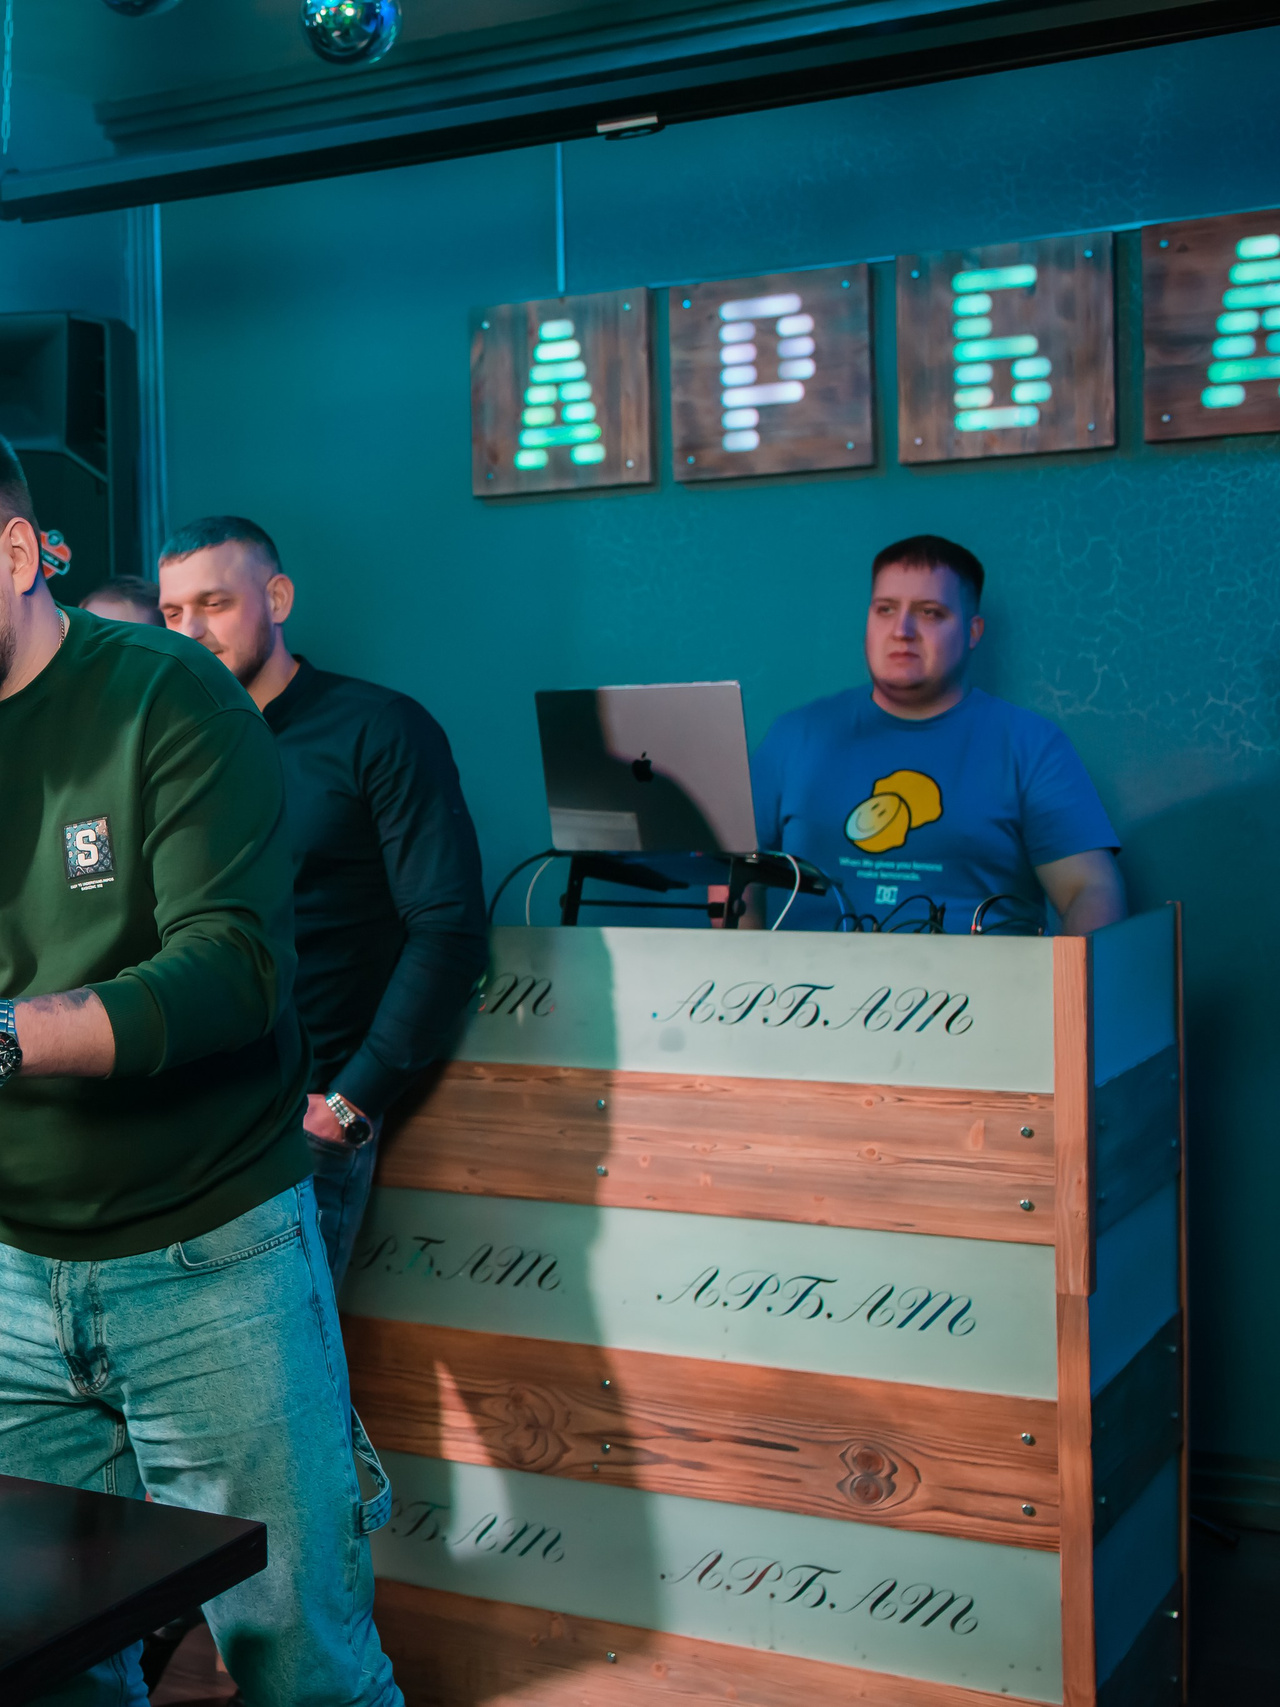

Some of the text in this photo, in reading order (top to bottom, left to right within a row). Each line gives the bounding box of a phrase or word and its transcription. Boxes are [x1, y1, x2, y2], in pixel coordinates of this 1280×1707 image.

[75, 828, 99, 867] S
[896, 861, 912, 871] you
[350, 1234, 562, 1292] РБАТ
